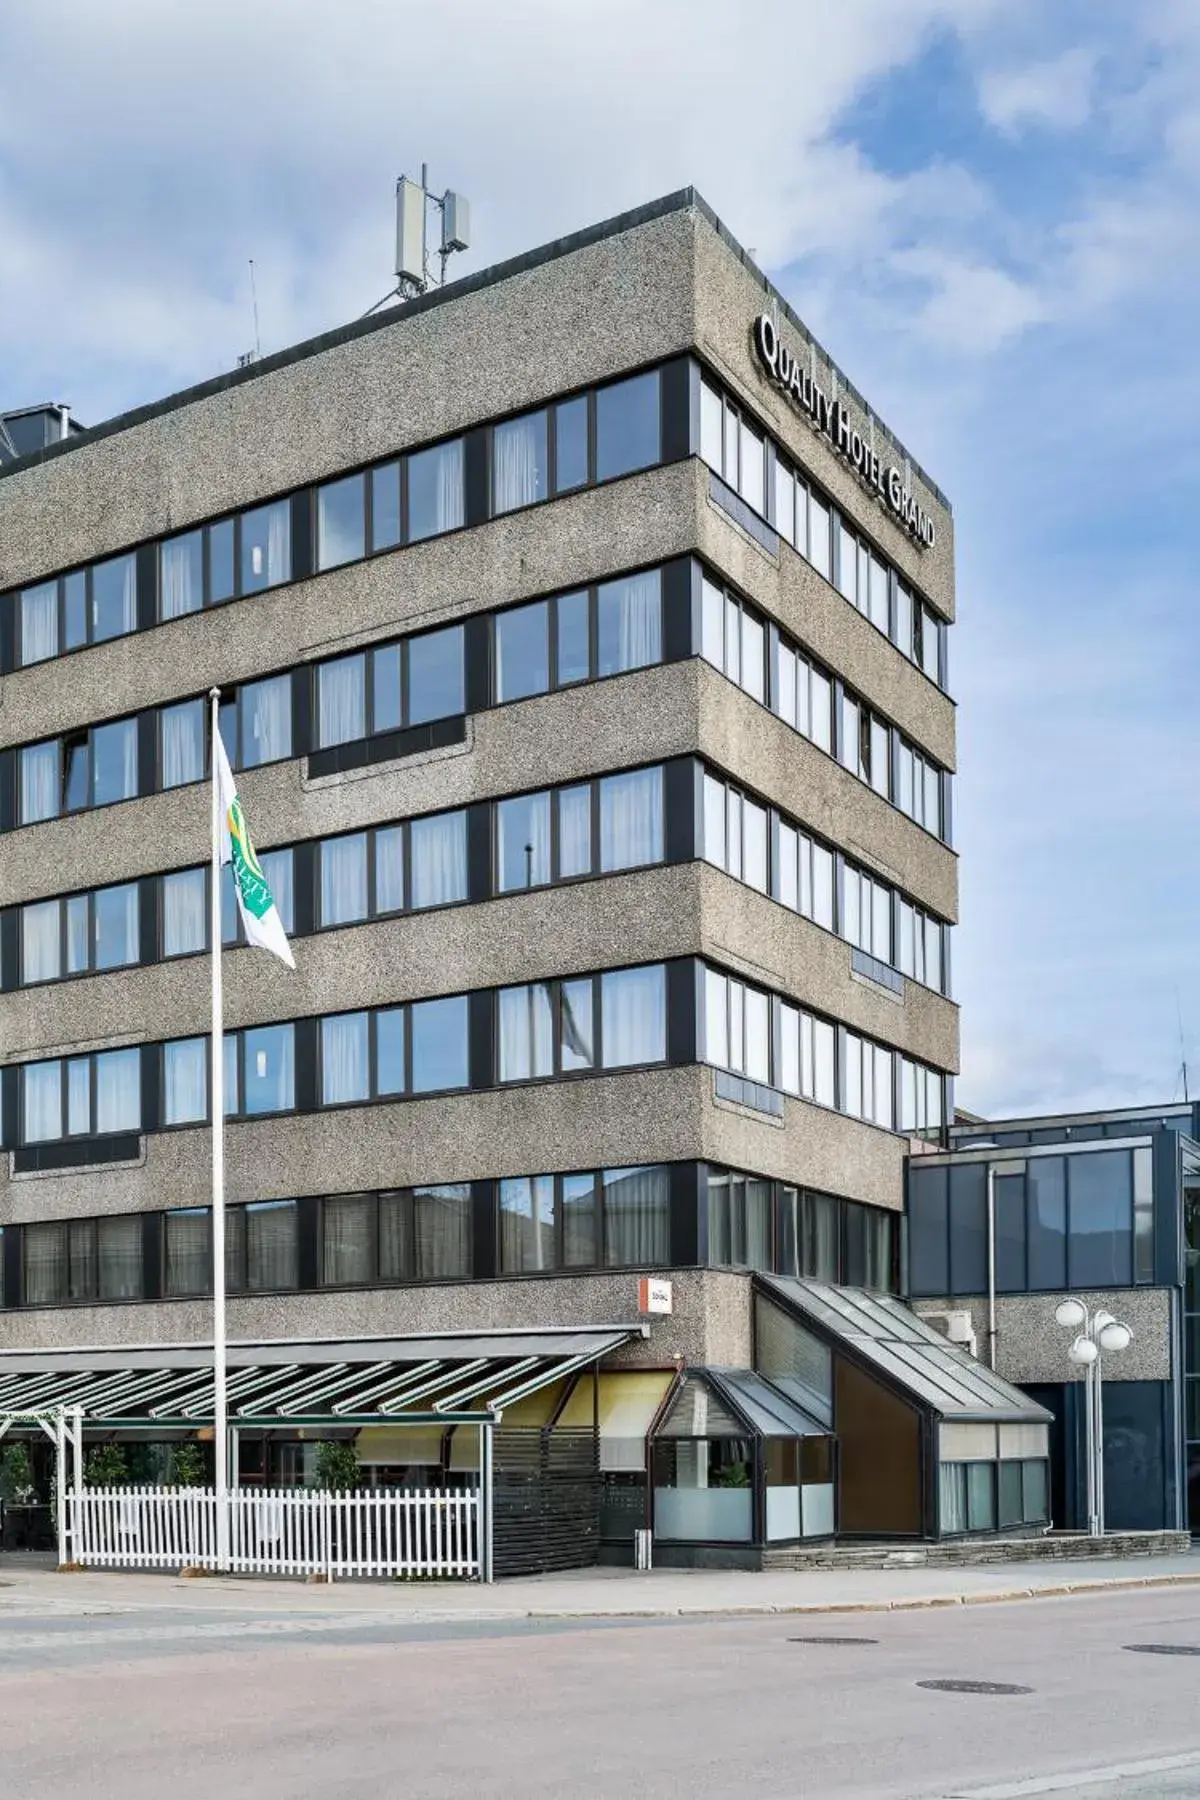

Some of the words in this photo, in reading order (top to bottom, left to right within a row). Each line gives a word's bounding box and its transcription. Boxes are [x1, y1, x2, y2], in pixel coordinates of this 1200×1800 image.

[756, 313, 834, 429] QUALITY
[835, 403, 886, 493] HOTEL
[887, 466, 936, 548] GRAND
